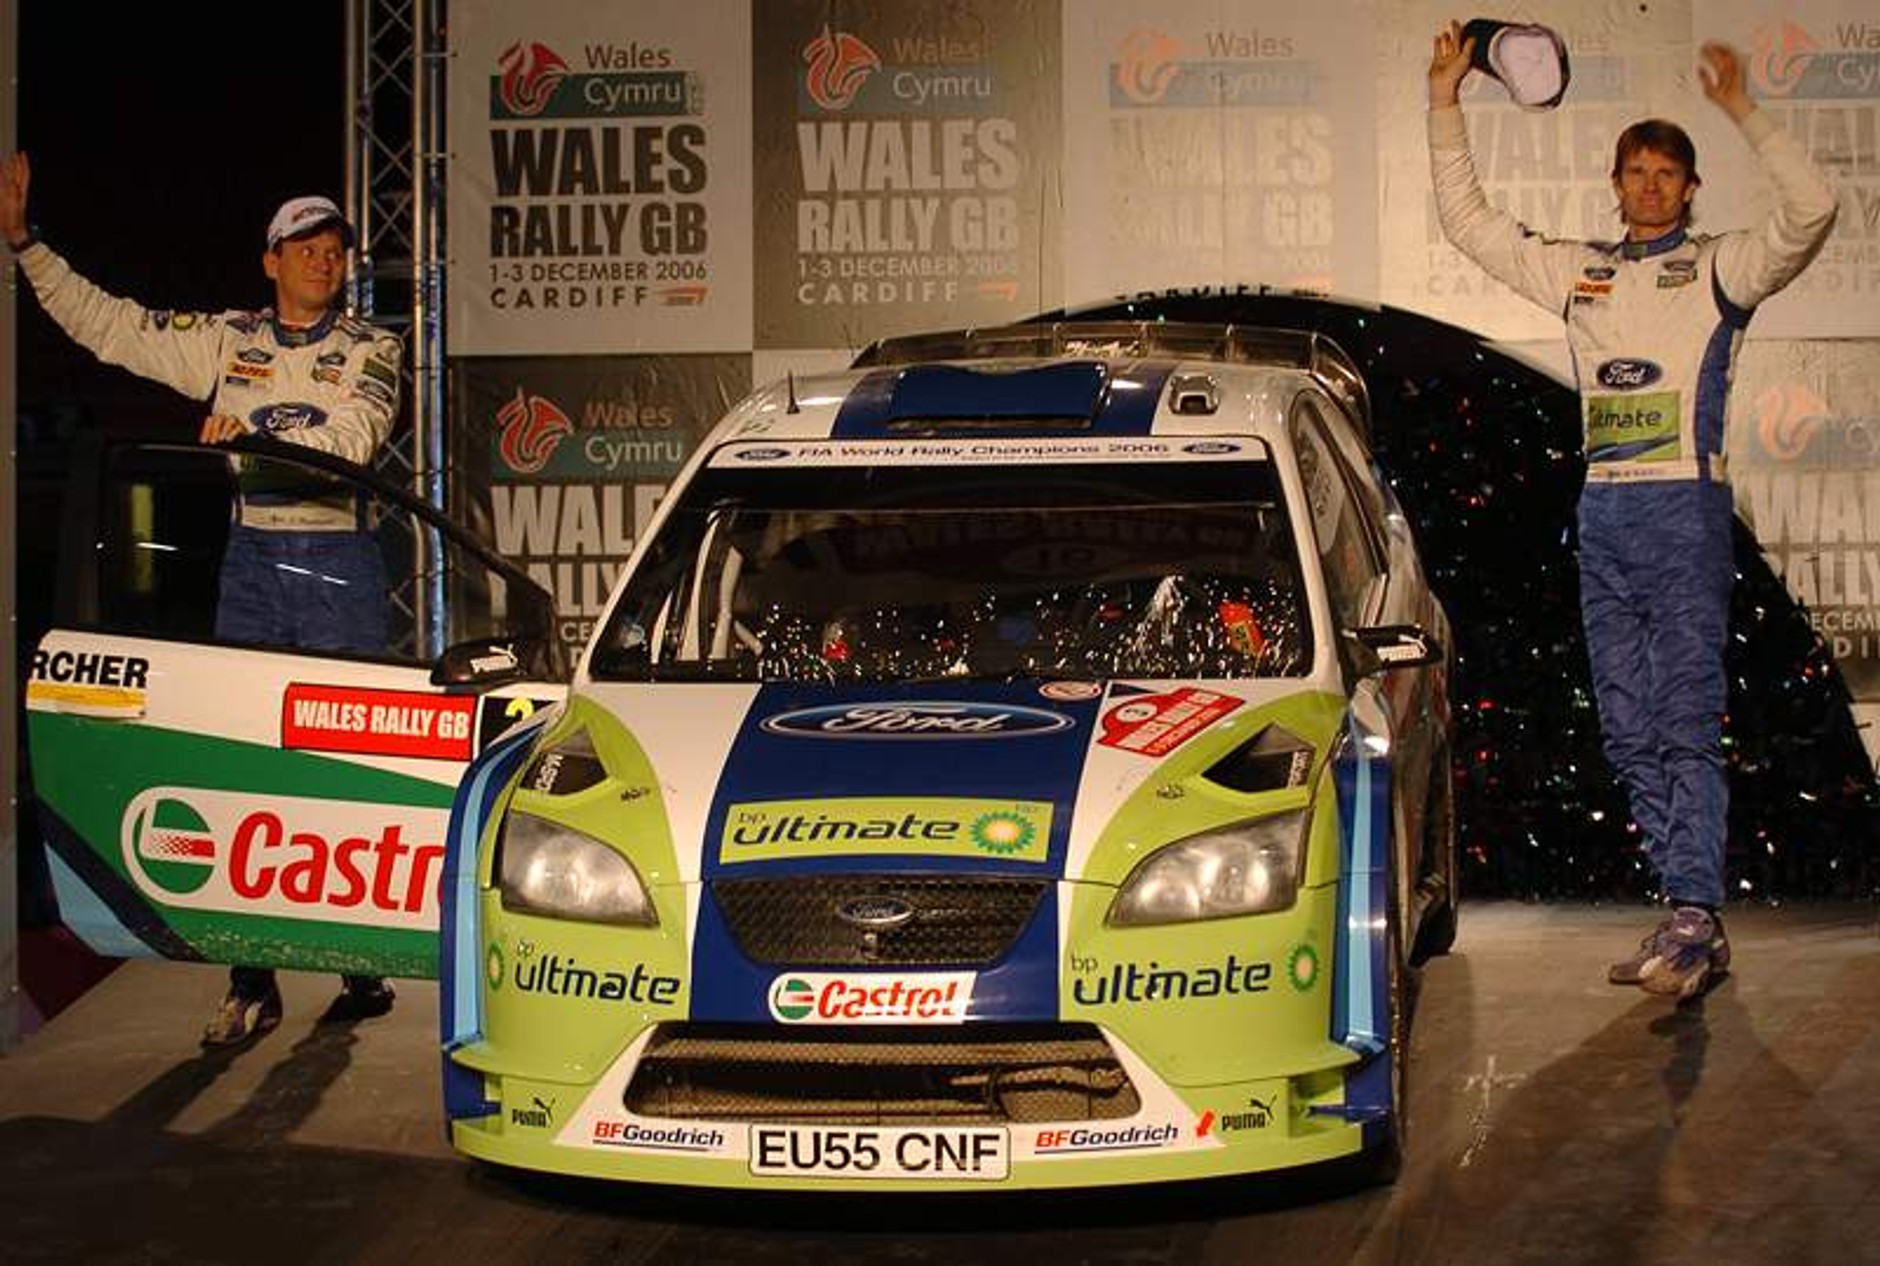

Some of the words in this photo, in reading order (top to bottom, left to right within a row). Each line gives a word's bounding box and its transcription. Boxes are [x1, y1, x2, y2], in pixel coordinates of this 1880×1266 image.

[584, 42, 672, 69] Wales
[1205, 31, 1295, 58] Wales
[583, 77, 681, 112] Cymru
[892, 70, 992, 105] Cymru
[489, 124, 708, 197] WALES
[797, 118, 1017, 192] WALES
[489, 203, 631, 257] RALLY
[639, 202, 708, 256] GB
[797, 199, 942, 251] RALLY
[949, 197, 1017, 251] GB
[489, 264, 524, 283] 1-3
[530, 262, 648, 282] DECEMBER
[655, 261, 707, 280] 2006
[798, 259, 832, 277] 1-3
[490, 286, 648, 309] CARDIFF
[797, 283, 958, 304] CARDIFF
[1604, 362, 1645, 384] Ford
[266, 407, 312, 430] Ford
[583, 402, 673, 427] Wales
[584, 436, 683, 470] Cymru
[841, 447, 904, 456] World
[911, 445, 962, 457] Rally
[971, 444, 1099, 456] Champions
[294, 700, 366, 733] WALES
[371, 705, 432, 737] RALLY
[437, 711, 469, 739] GB
[822, 706, 1010, 733] Ford
[733, 814, 961, 846] ultimate
[228, 810, 444, 913] Castr
[1072, 954, 1098, 973] bp
[514, 954, 681, 1005] ultimate
[1074, 955, 1271, 1005] ultimate
[817, 979, 959, 1020] Castrol
[511, 1108, 547, 1129] PUMA
[1221, 1113, 1266, 1131] PUMA
[594, 1120, 724, 1147] BFGoodrich
[1036, 1124, 1179, 1149] BFGoodrich
[758, 1130, 881, 1171] EU55
[895, 1132, 1000, 1171] CNF
